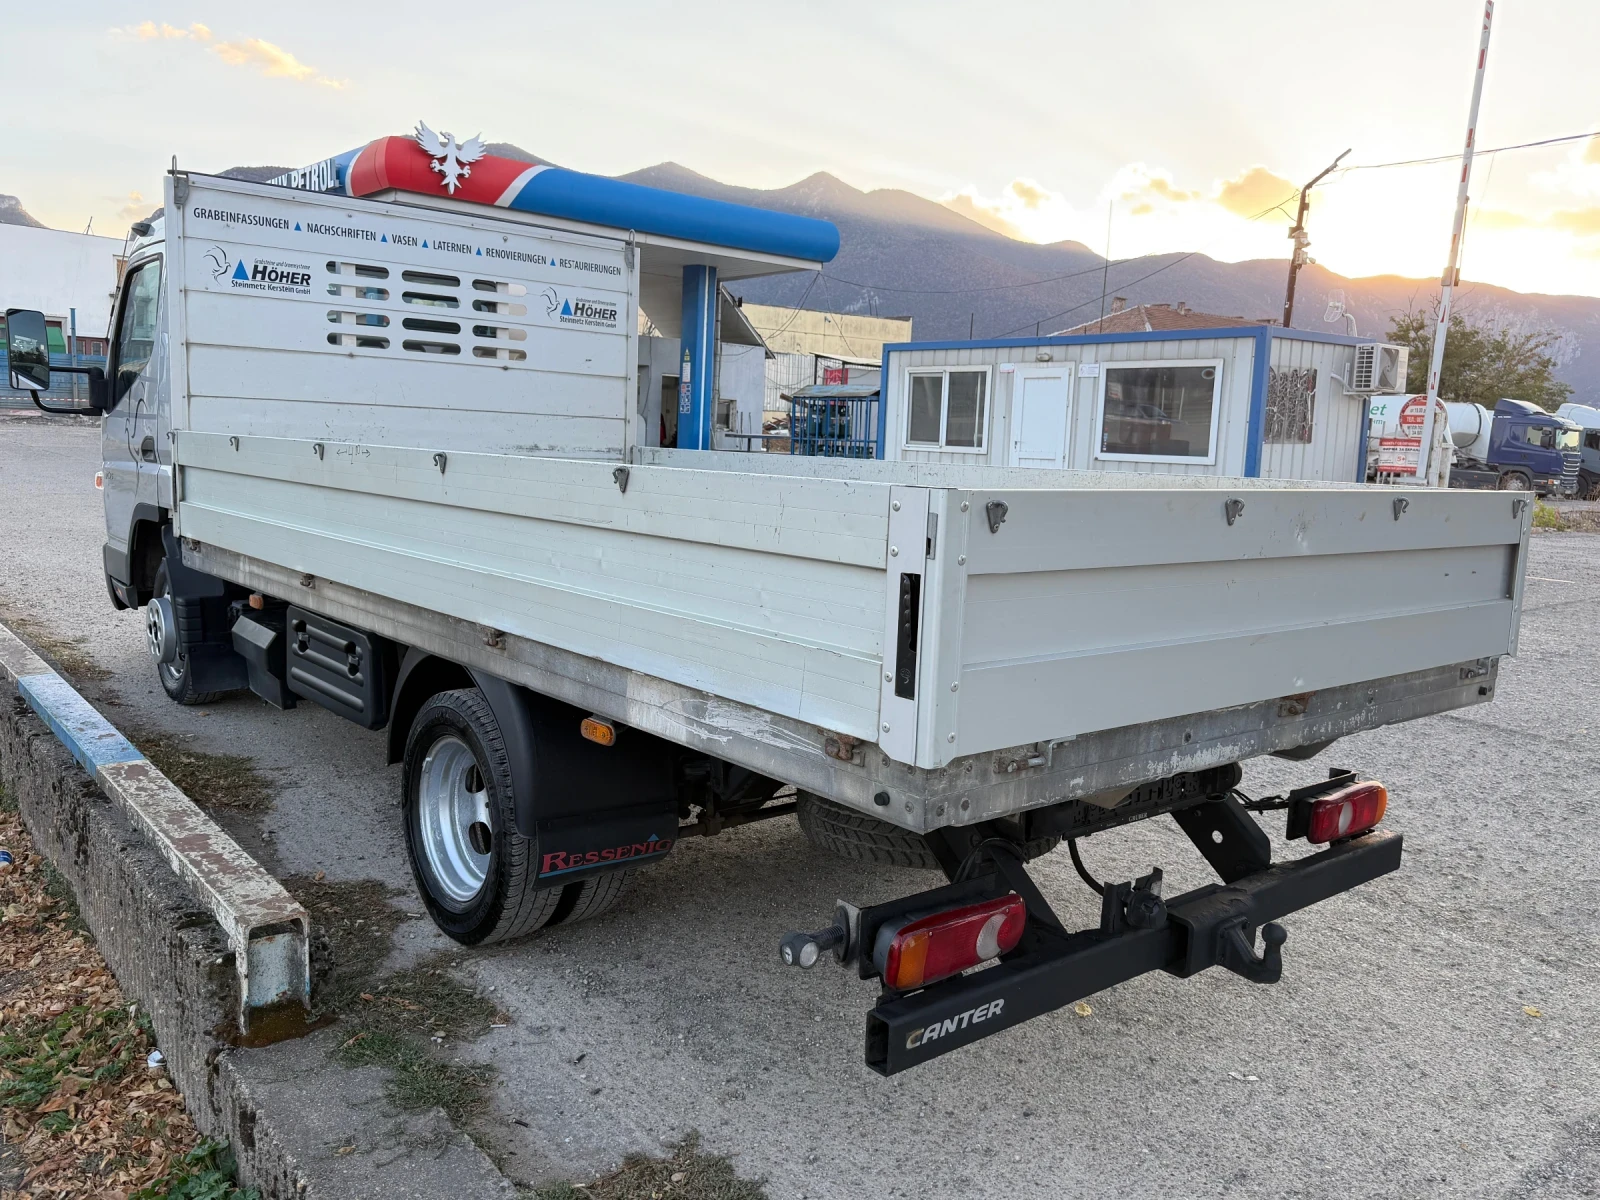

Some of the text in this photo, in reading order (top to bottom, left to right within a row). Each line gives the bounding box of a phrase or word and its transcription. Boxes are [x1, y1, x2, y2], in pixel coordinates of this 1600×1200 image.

[290, 158, 338, 192] PETROL
[193, 207, 621, 276] GRABEINFASSUNGEN NACHSCHRIFTEN VASEN LATERNEN RENOVIERUNGEN RESTAURIERUNGEN
[231, 280, 266, 291] Steinmetz
[267, 283, 295, 293] Kerstein
[251, 264, 311, 286] HÖHER
[560, 315, 584, 325] Steinmetz
[585, 319, 605, 327] Kerstein
[573, 302, 617, 321] HÖHER
[540, 839, 673, 874] RESSENIG
[905, 998, 1005, 1050] CANTER
